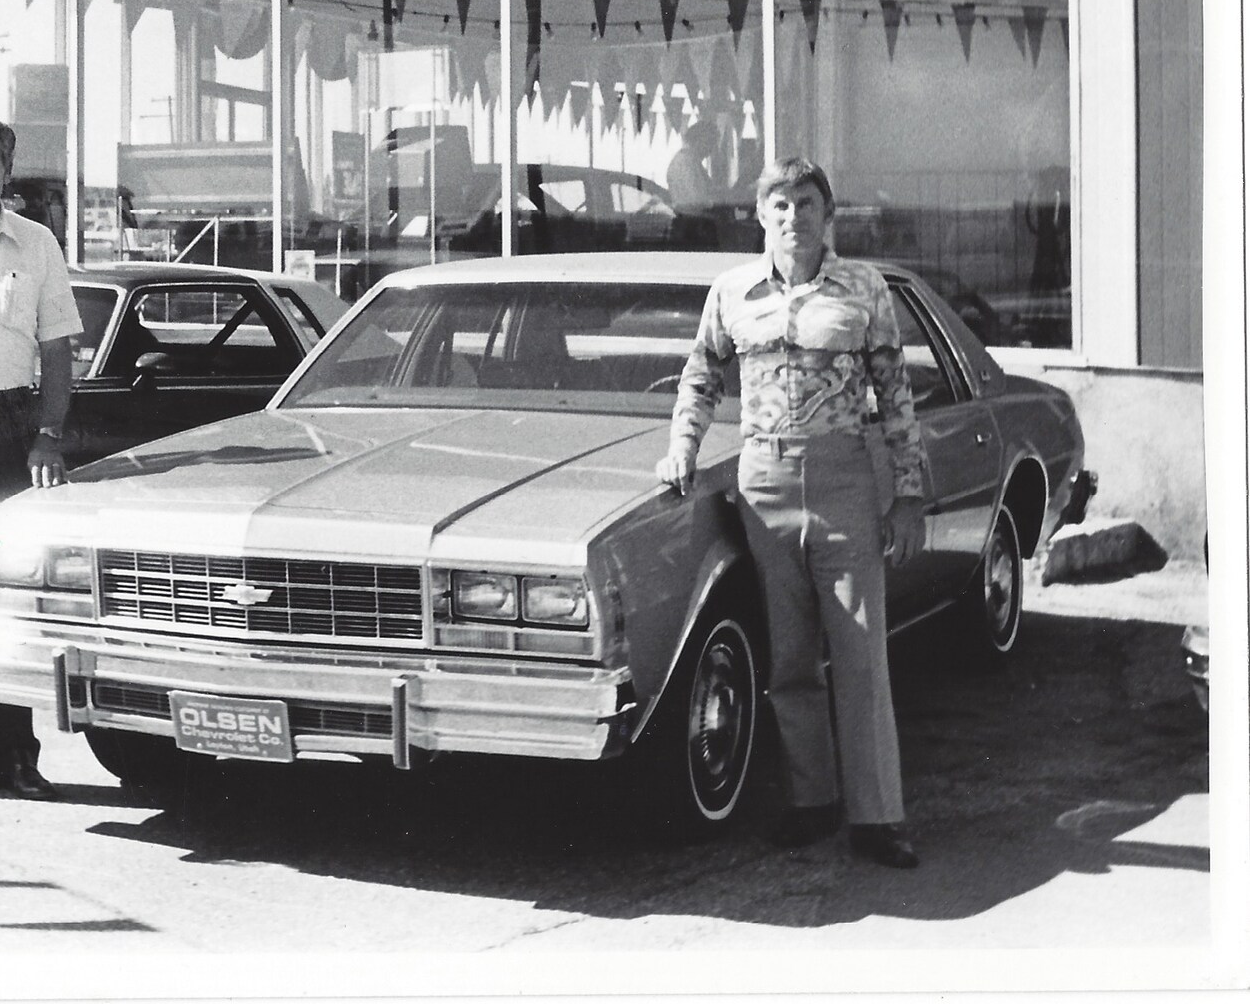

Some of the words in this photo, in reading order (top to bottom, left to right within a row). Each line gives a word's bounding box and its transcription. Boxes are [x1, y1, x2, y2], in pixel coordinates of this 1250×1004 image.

[179, 707, 283, 734] OLSEN
[181, 725, 257, 743] Chevrolet
[258, 733, 284, 745] Co.
